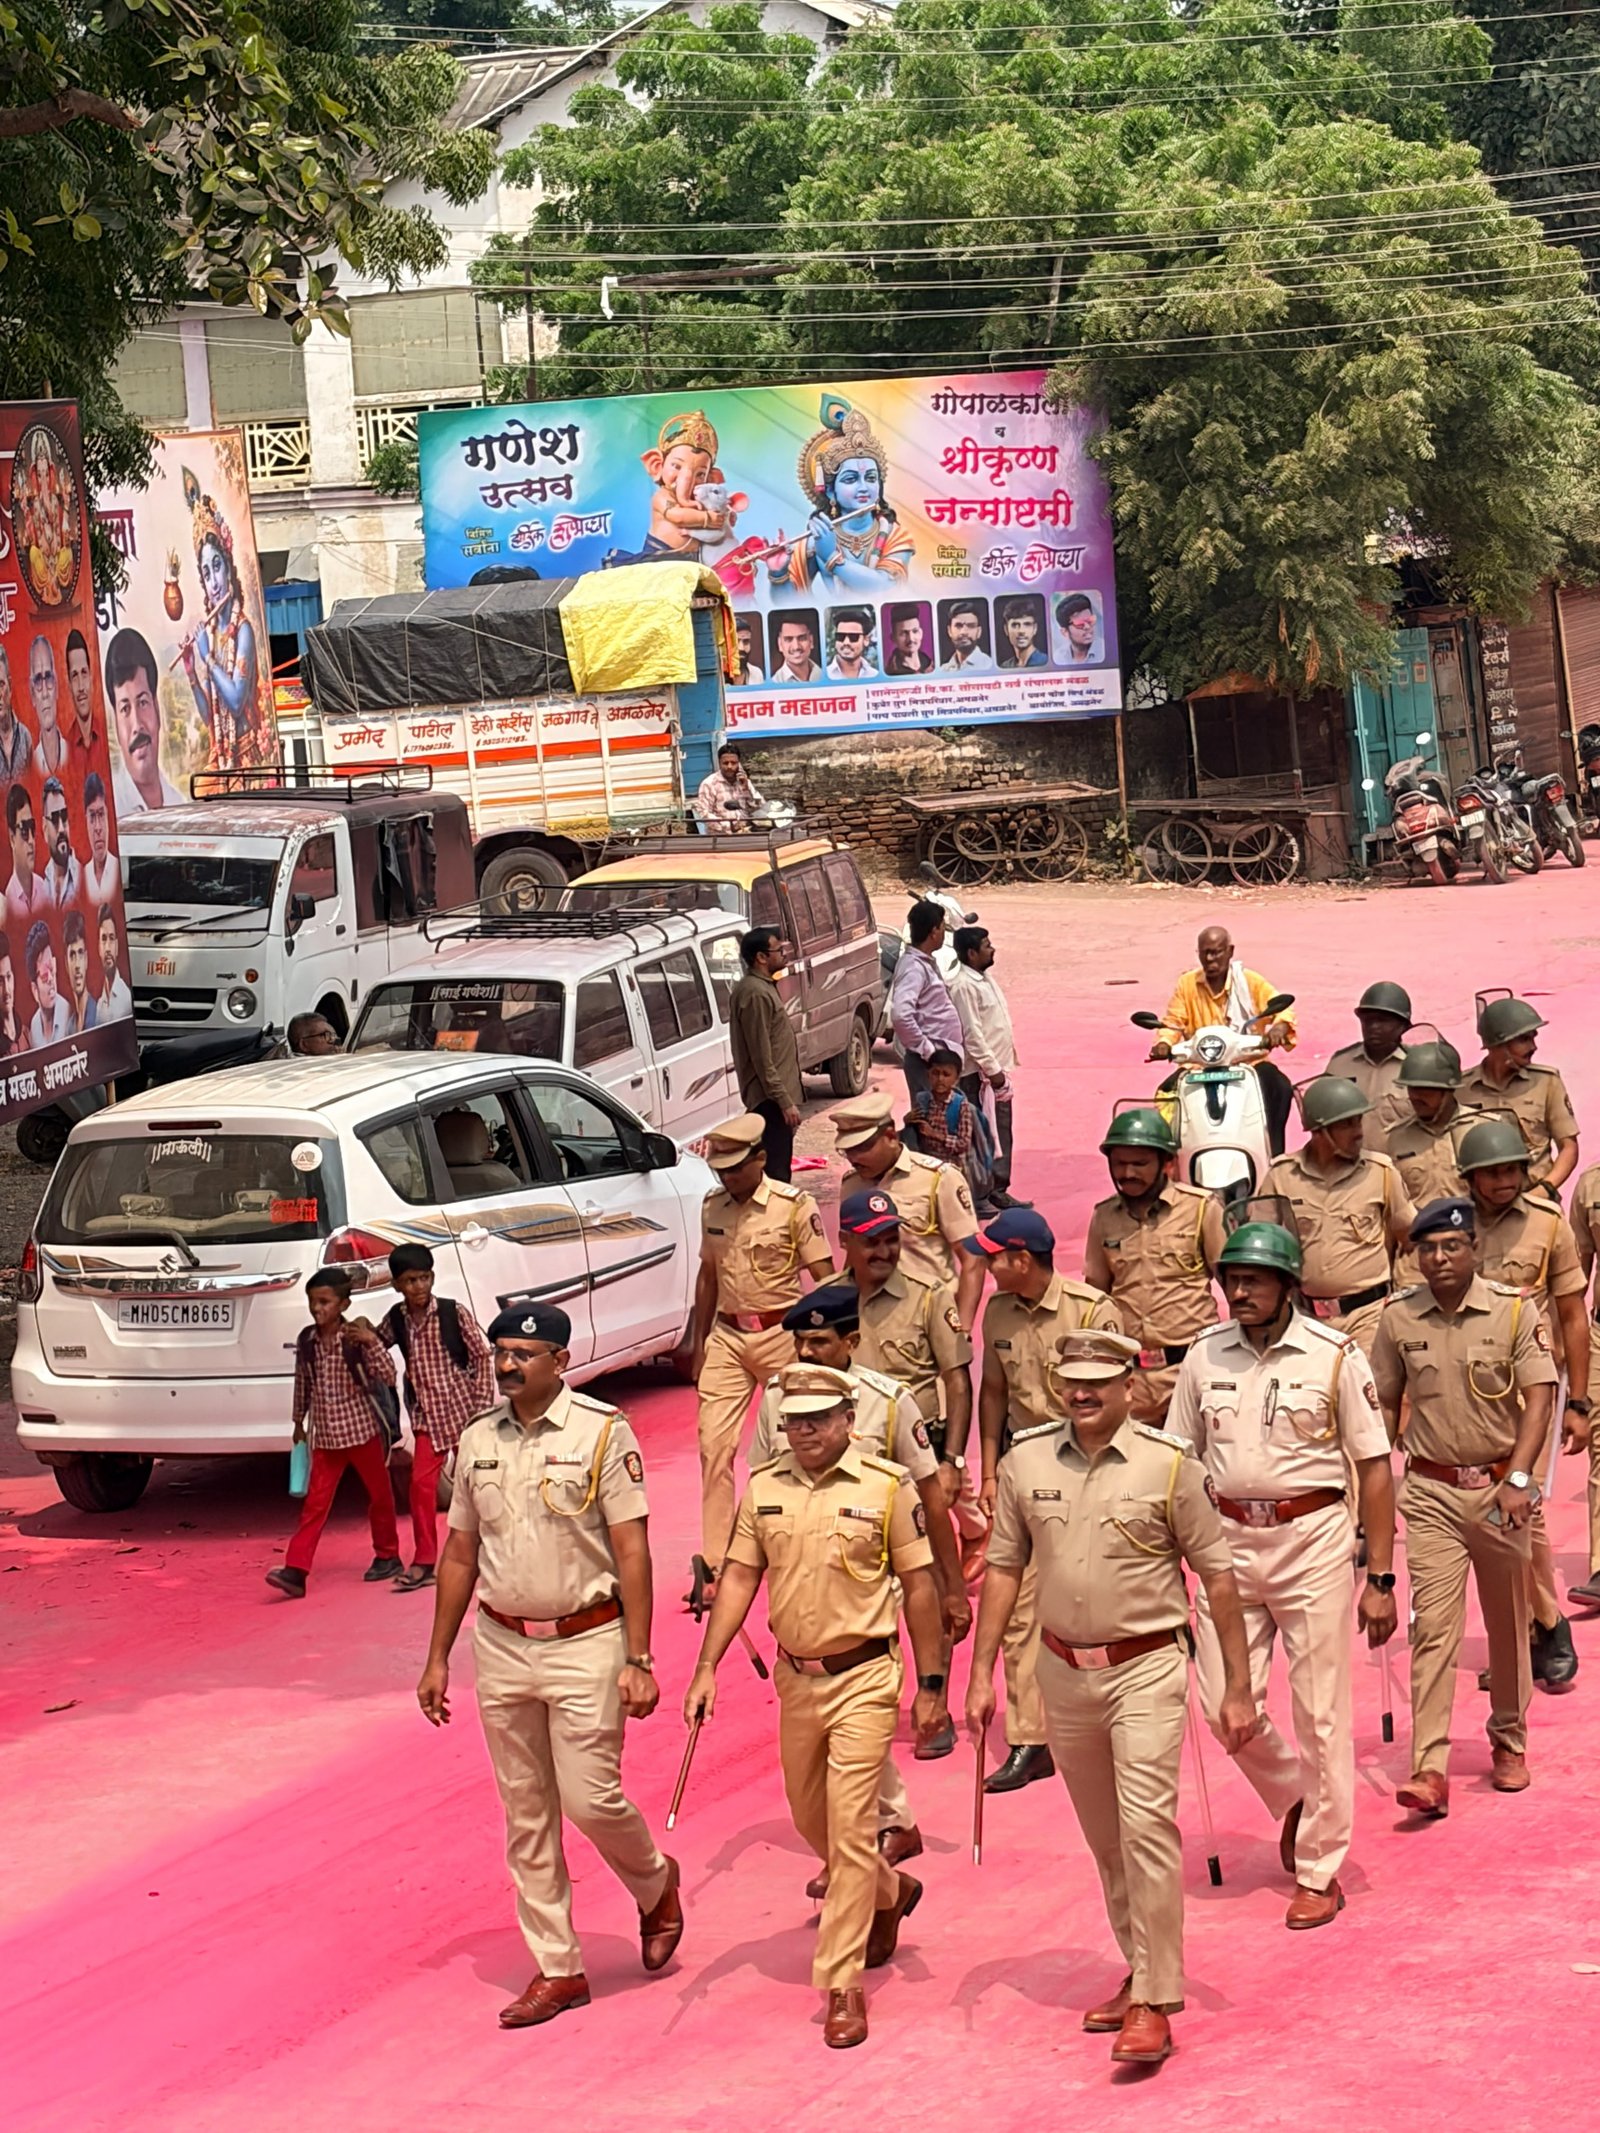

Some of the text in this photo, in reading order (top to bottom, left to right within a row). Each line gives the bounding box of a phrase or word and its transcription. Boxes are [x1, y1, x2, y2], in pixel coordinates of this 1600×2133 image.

[461, 419, 580, 471] गणेश
[940, 437, 1059, 486] श्रीकृष्ण
[480, 474, 573, 508] उत्सव
[925, 489, 1073, 527] जन्माष्टमी
[779, 696, 857, 716] महाजन
[334, 724, 386, 750] प्रमोद
[408, 719, 456, 740] पाटील
[470, 715, 493, 735] डेली
[43, 1044, 89, 1091] अमळनेर
[131, 1304, 230, 1323] MH05CM8665
